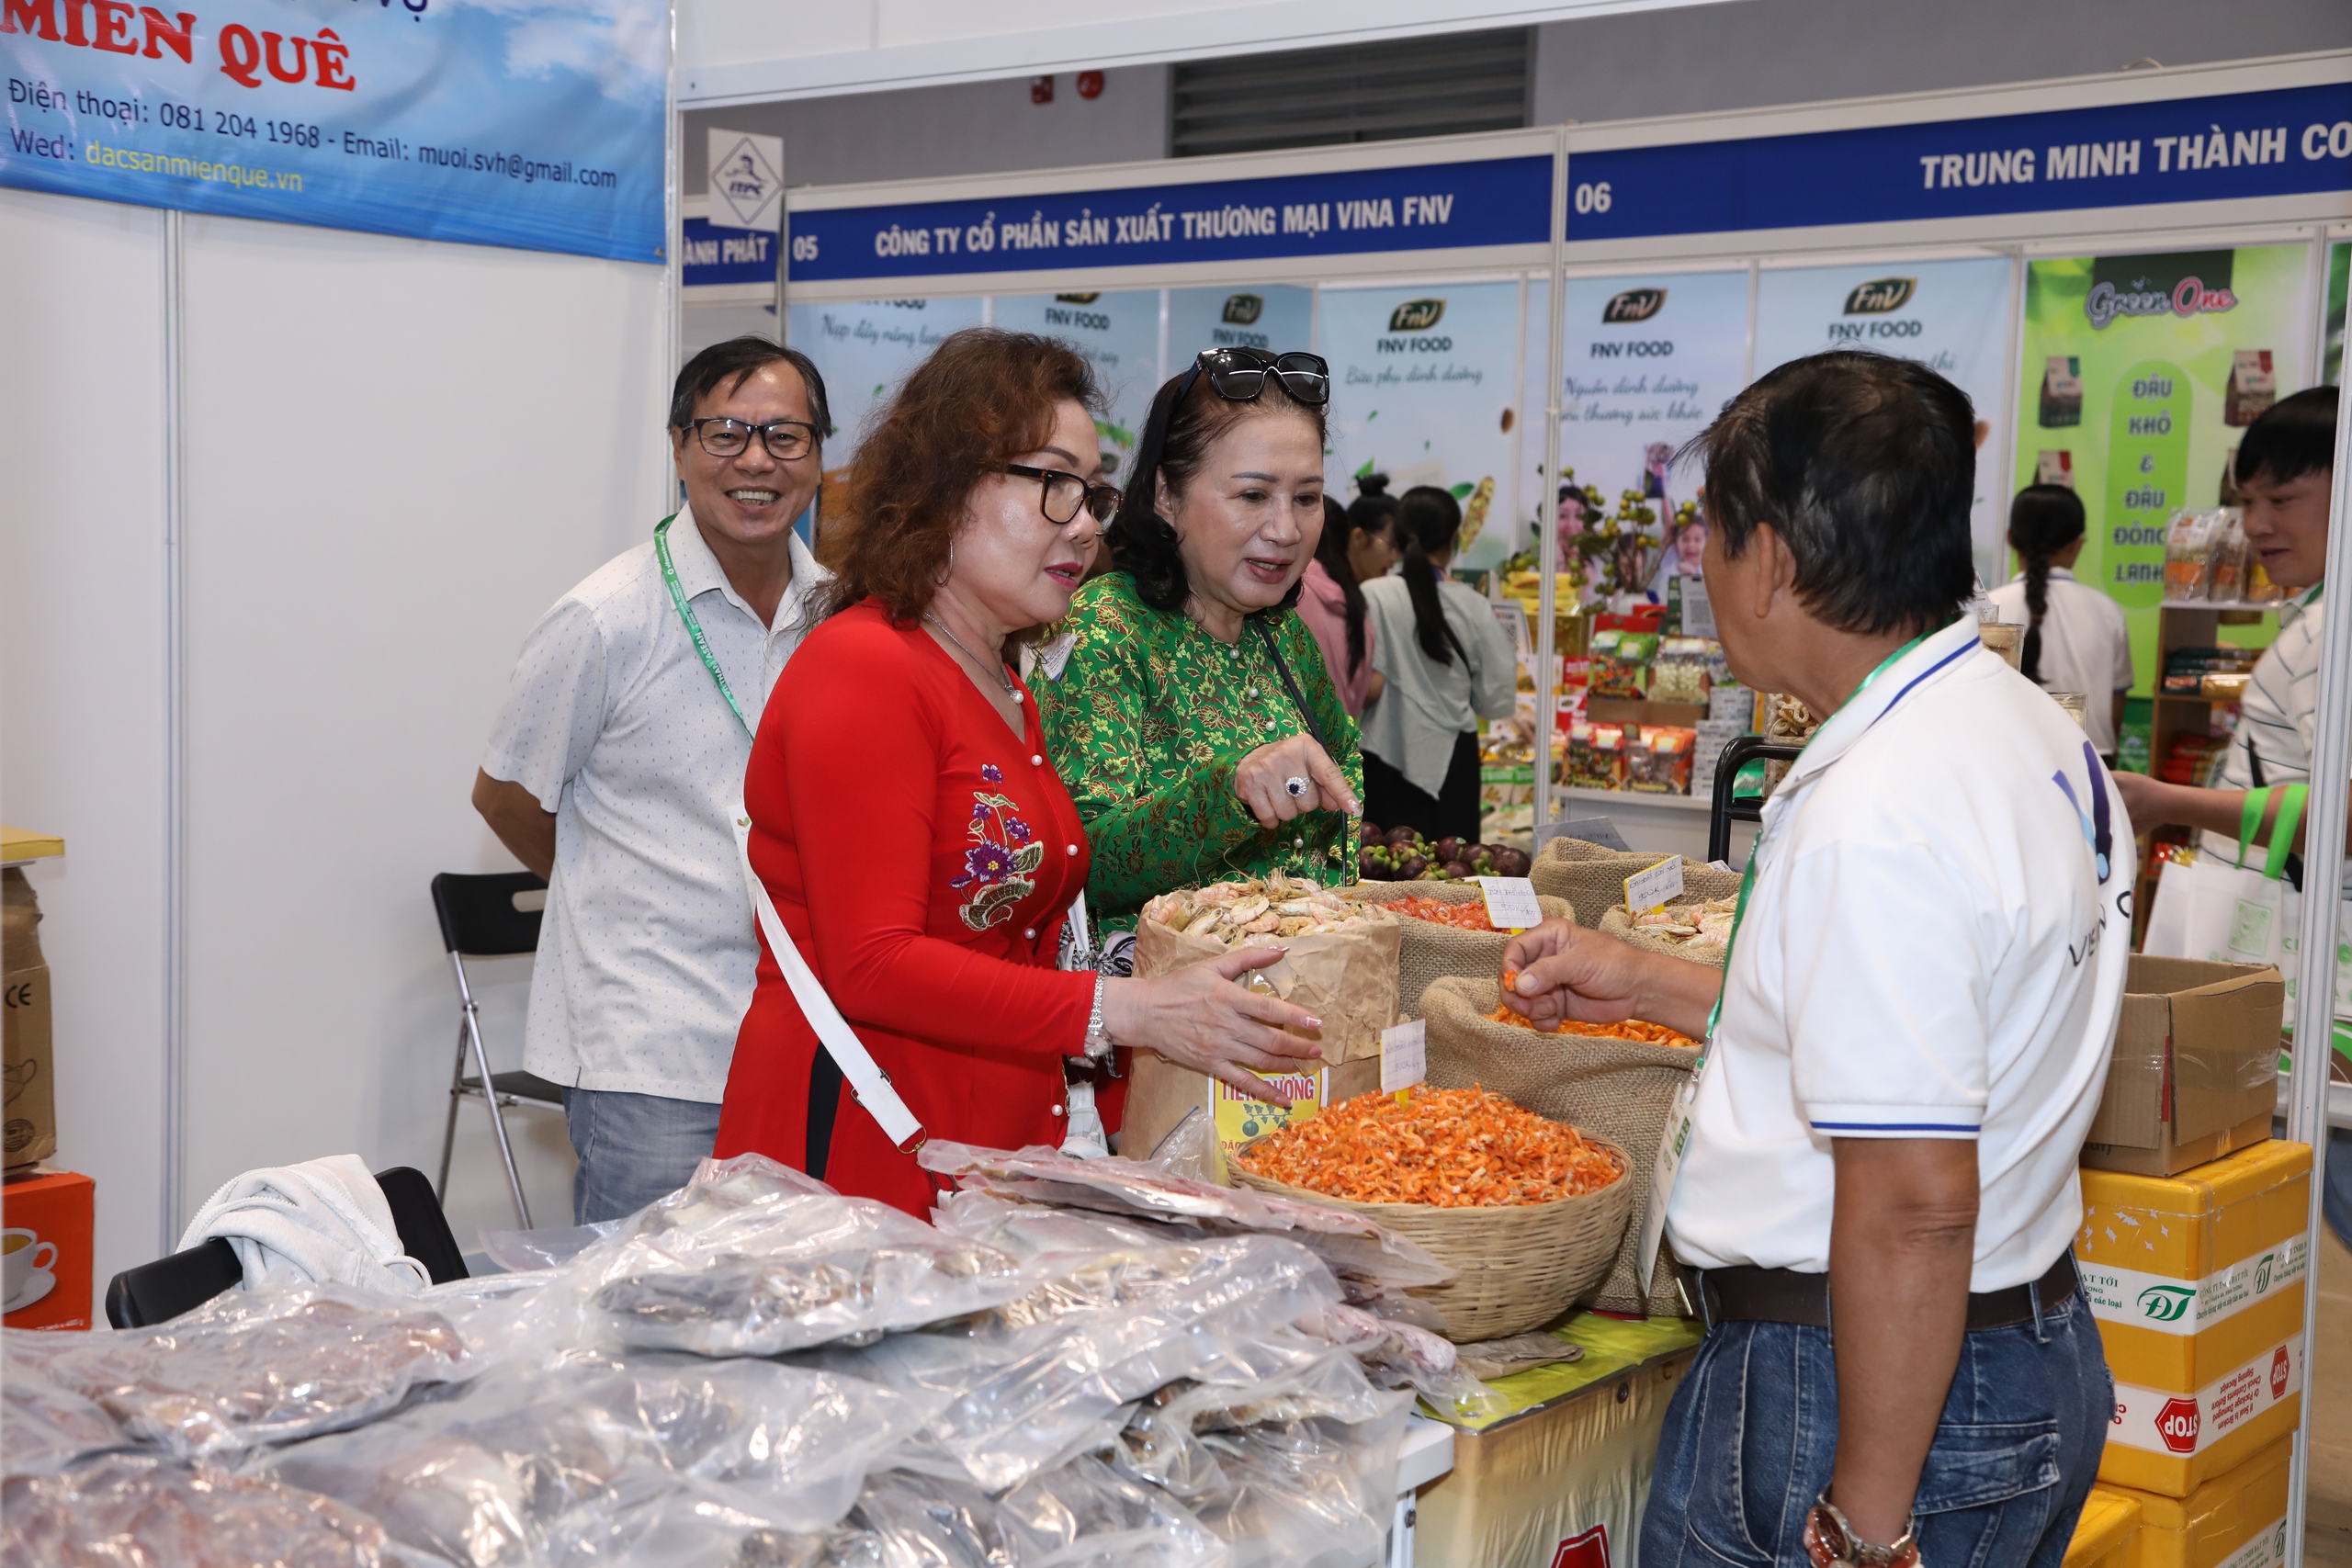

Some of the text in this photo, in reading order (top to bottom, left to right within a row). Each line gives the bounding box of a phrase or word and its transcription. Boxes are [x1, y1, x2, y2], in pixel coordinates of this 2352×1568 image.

[219, 23, 356, 92] QUÊ
[8, 78, 66, 113] Điện
[76, 90, 149, 125] thoại:
[160, 103, 205, 131] 081
[215, 111, 258, 139] 204
[266, 120, 320, 149] 1968
[344, 131, 410, 161] Email:
[418, 145, 617, 188] muoi.svh@gmail.com
[10, 128, 303, 192] Wed: dacsanmienque.vn
[1919, 148, 2036, 189] TRUNG
[2045, 140, 2141, 181] MINH
[2153, 124, 2287, 173] THÀNH
[1575, 182, 1611, 215] 06
[875, 193, 1454, 257] CÔNG TY CỔ PHẦN SẢN XUẤT THƯƠNG MẠI VINA FNV
[722, 231, 769, 265] PHÁT
[792, 235, 819, 262] 05
[2085, 276, 2238, 330] Green One
[1045, 308, 1111, 331] FNV FOOD
[1827, 320, 1923, 340] FNV FOOD
[1213, 328, 1269, 349] FNV FOOD
[1377, 336, 1453, 354] FNV FOOD
[1590, 340, 1674, 358] FNV FOOD
[2131, 371, 2174, 405] ĐẬU
[2128, 408, 2174, 436] KHÔ
[2123, 482, 2165, 514] ĐẬU
[695, 631, 713, 660] ASEAN
[5, 983, 32, 1009] CE
[2098, 1276, 2119, 1288] TỚI
[2094, 1296, 2107, 1305] các
[2108, 1297, 2122, 1309] loại
[2247, 1375, 2261, 1388] Check
[2273, 1359, 2287, 1385] STOP
[2220, 1377, 2237, 1395] Receipt
[2211, 1395, 2227, 1410] Before
[2234, 1391, 2254, 1408] Package
[2164, 1414, 2199, 1438] STOP
[2217, 1415, 2234, 1430] Broken
